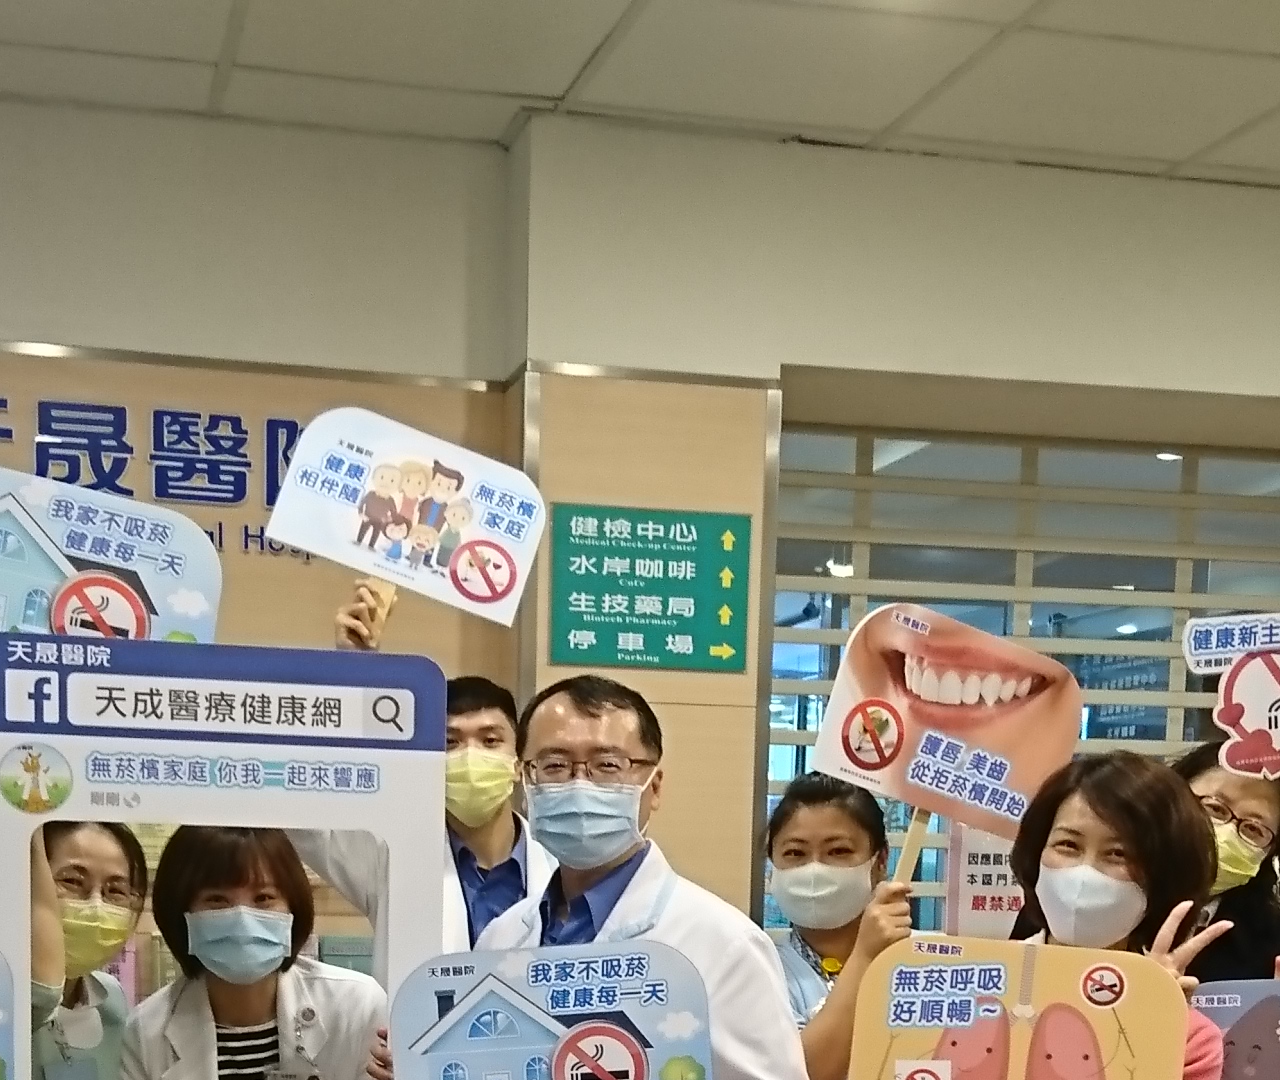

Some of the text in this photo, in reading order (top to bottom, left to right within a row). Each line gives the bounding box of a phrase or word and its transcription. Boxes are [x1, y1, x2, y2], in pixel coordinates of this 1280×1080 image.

[324, 453, 367, 481] 健康
[298, 468, 363, 504] 相伴隨
[475, 484, 538, 520] 無菸檳
[50, 498, 173, 546] 我家不吸菸
[483, 511, 526, 539] 家庭
[569, 516, 698, 543] 健檢中心
[64, 529, 185, 576] 健康每一天
[569, 555, 696, 580] 水岸咖啡
[568, 592, 695, 617] 生技藥局
[7, 640, 113, 669] 天晟醫院
[567, 629, 694, 655] 停車場
[95, 685, 342, 728] 天成醫療健康網
[90, 755, 377, 789] 無菸檳家庭 你我一起來響應
[968, 751, 1009, 781] 美齒
[910, 760, 1027, 818] 從拒菸檳開始
[427, 964, 476, 979] 天晟醫院
[530, 955, 647, 985] 我家不吸菸
[894, 967, 1003, 993] 無菸呼吸
[549, 980, 668, 1010] 健康每一天
